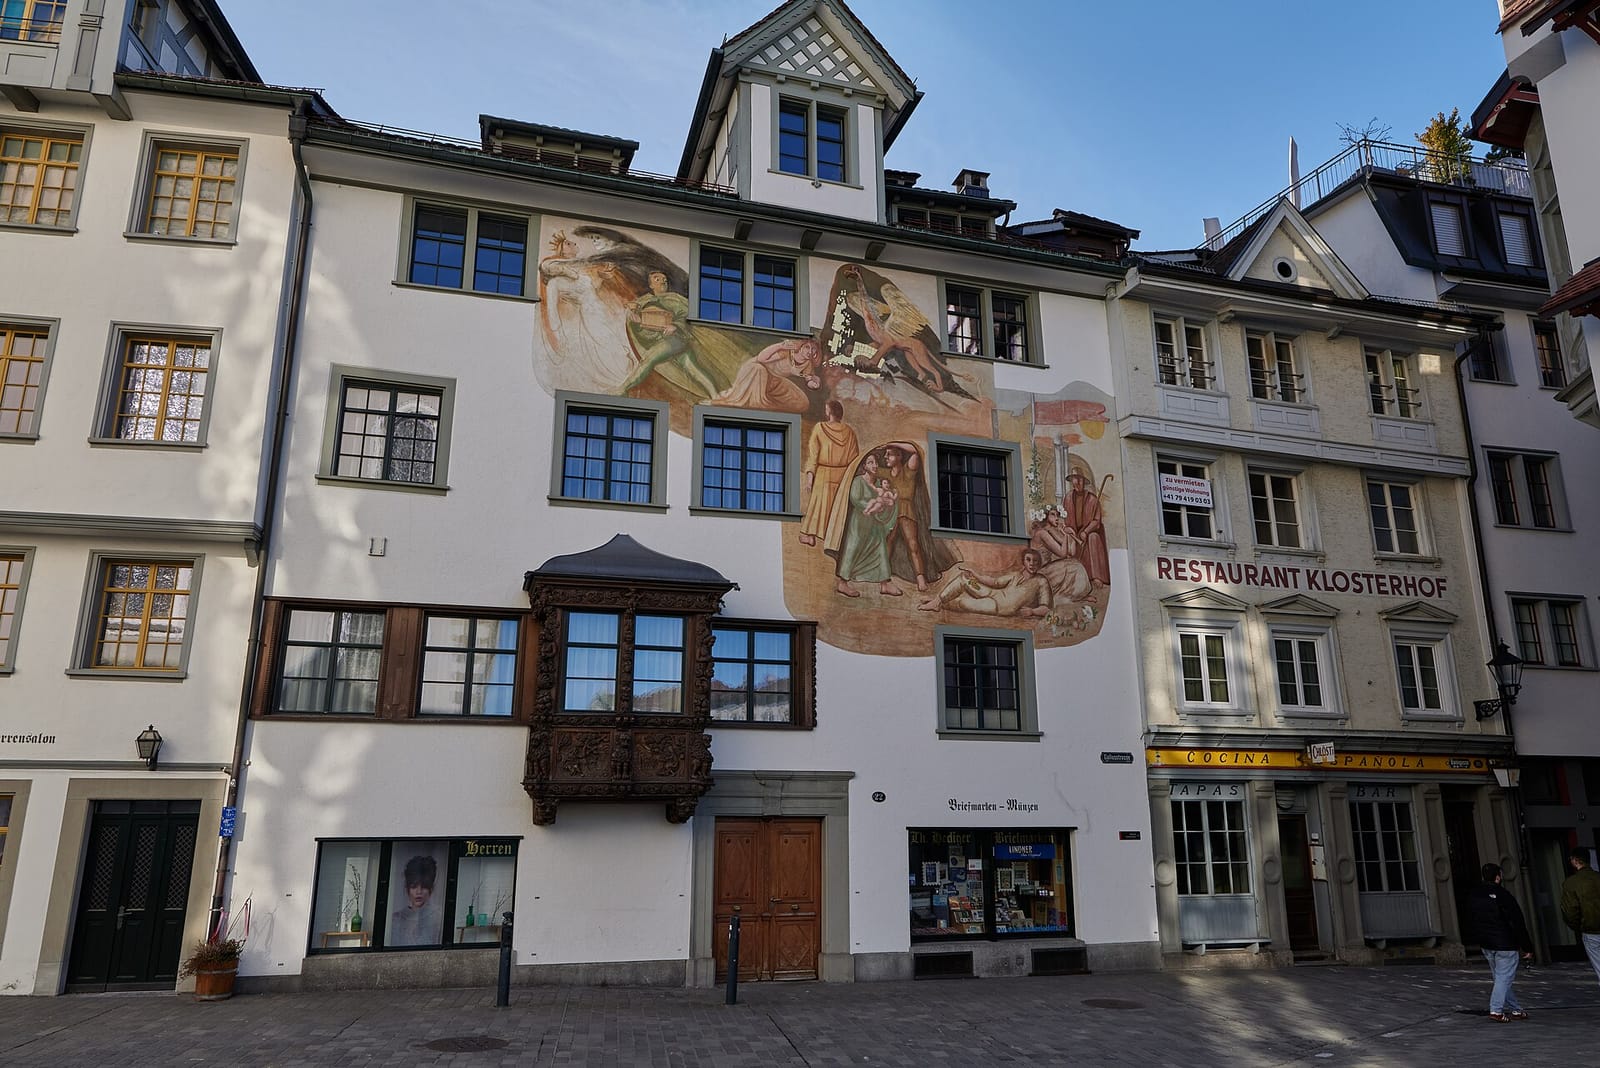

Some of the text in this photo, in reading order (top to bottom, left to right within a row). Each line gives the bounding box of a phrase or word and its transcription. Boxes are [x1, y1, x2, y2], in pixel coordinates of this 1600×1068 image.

[1174, 478, 1205, 487] vermieten
[1162, 485, 1209, 497] günstige Wohnung
[1156, 556, 1448, 598] RESTAURANT KLOSTERHOF
[1187, 751, 1425, 768] COCINA SPAÑOLA
[1169, 783, 1239, 796] TAPAS
[1356, 785, 1396, 798] BAR
[873, 792, 884, 801] 22
[948, 798, 997, 812] Briefmarken
[1006, 798, 1039, 813] Münzen
[465, 840, 512, 856] Herren
